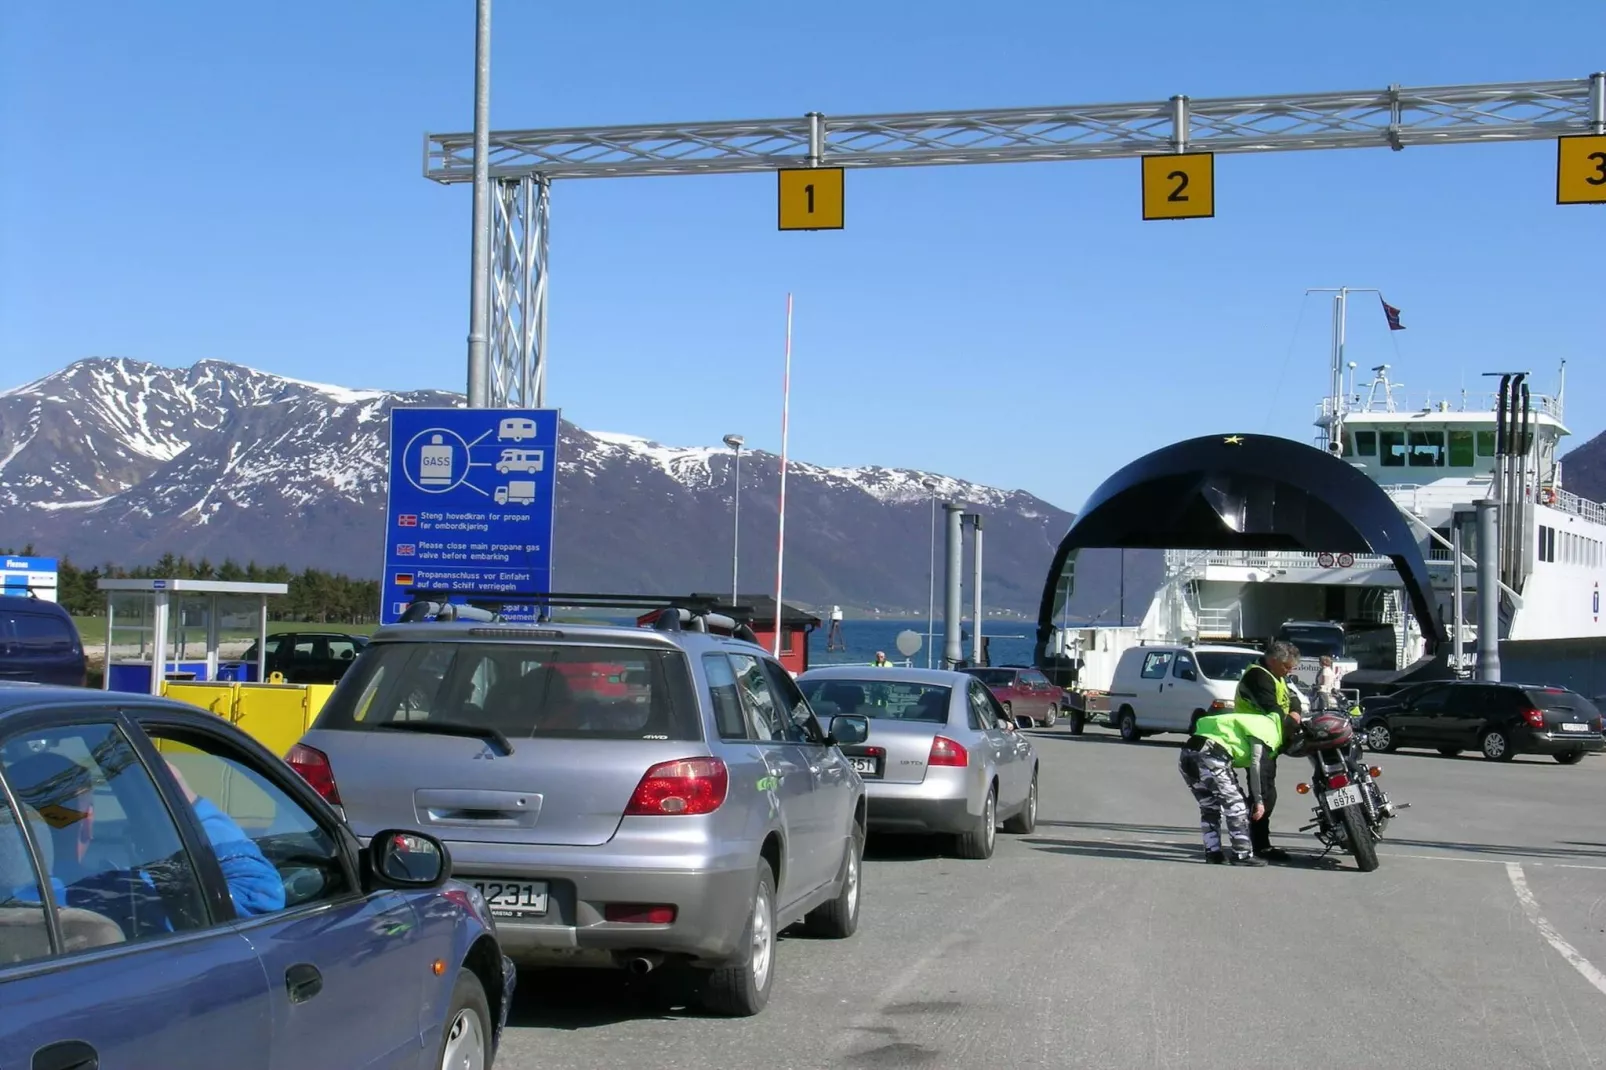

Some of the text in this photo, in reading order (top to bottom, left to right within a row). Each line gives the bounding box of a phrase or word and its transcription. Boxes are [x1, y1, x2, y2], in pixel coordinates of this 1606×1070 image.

[1585, 152, 1606, 185] 3
[1167, 171, 1189, 202] 2
[805, 184, 815, 213] 1
[423, 456, 450, 466] GASS
[421, 512, 443, 521] Steng
[446, 512, 485, 520] hovedkran
[503, 513, 530, 522] propan
[418, 541, 443, 549] Please
[446, 541, 467, 549] close
[470, 542, 489, 550] main
[491, 543, 522, 552] propane
[470, 552, 509, 561] embarking
[417, 570, 480, 580] Propananschluss
[499, 572, 530, 581] Einfahrt
[452, 581, 475, 589] Schiff
[478, 582, 517, 591] verriegeln
[1333, 795, 1356, 807] 6978
